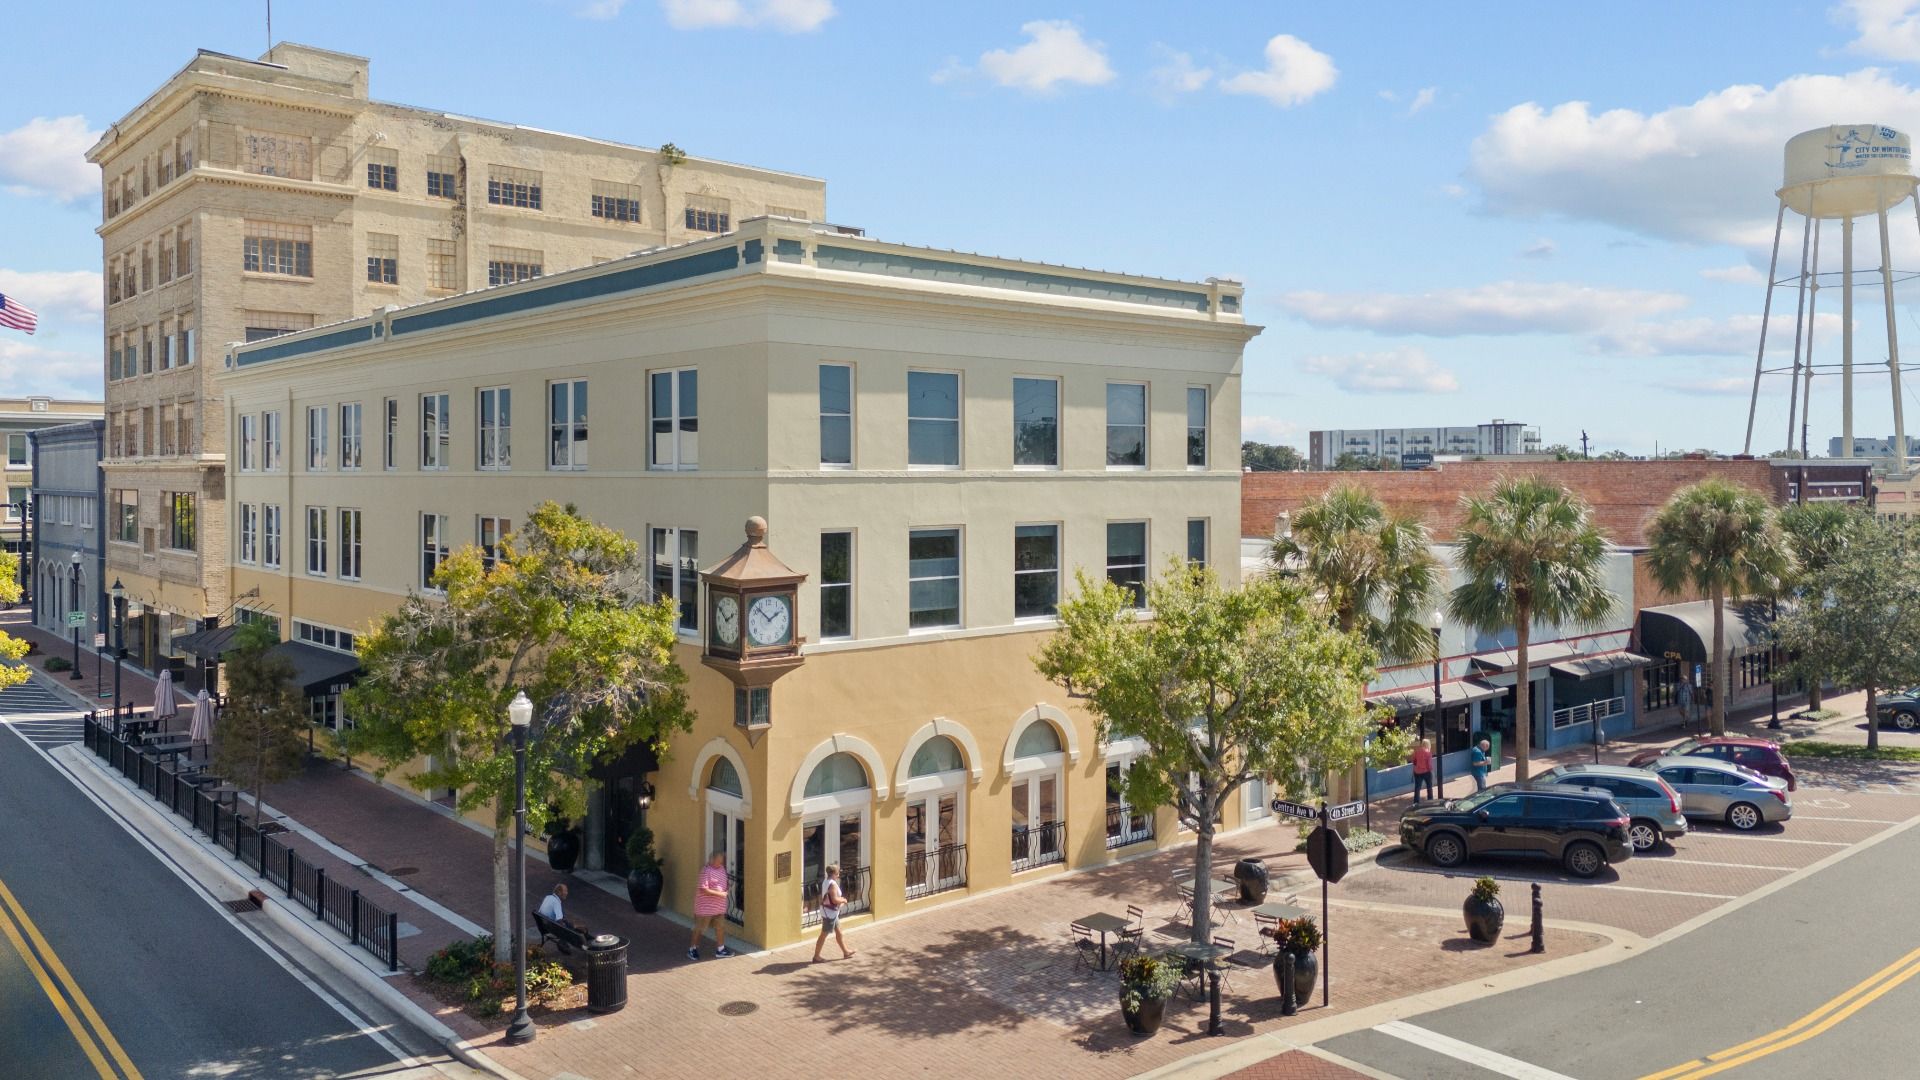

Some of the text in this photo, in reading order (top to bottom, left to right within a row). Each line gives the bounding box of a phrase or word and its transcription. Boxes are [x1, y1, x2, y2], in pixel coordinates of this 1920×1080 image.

[1663, 651, 1682, 660] CPA
[1274, 801, 1314, 818] Central Ave W
[1332, 803, 1363, 819] 4th Street SW
